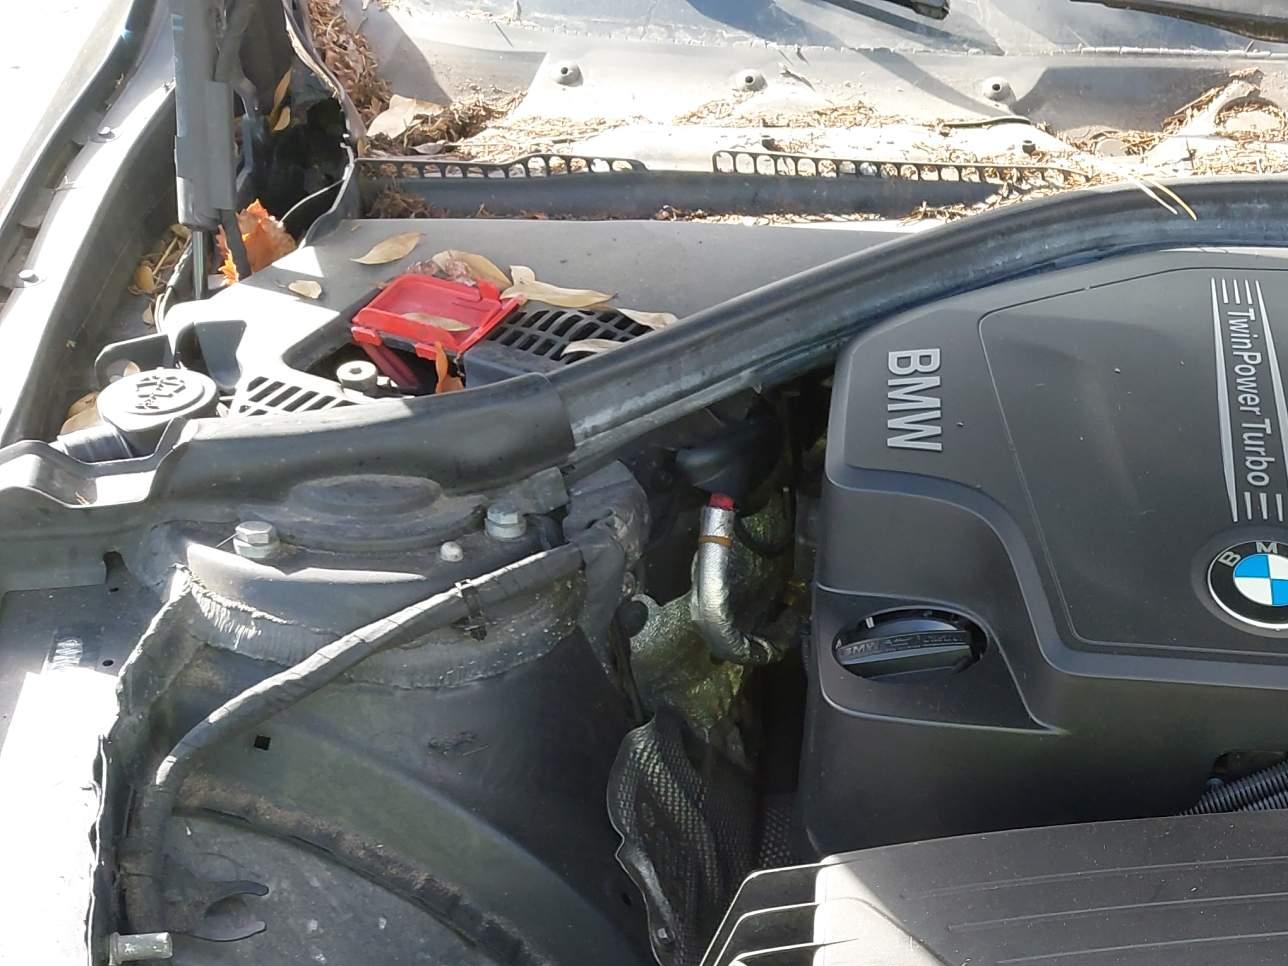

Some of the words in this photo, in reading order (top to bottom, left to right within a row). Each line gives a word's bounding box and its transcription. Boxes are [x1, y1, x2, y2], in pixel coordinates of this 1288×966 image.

[887, 348, 943, 453] BMW
[1227, 307, 1262, 416] TwinPower
[1241, 417, 1276, 487] Turbo
